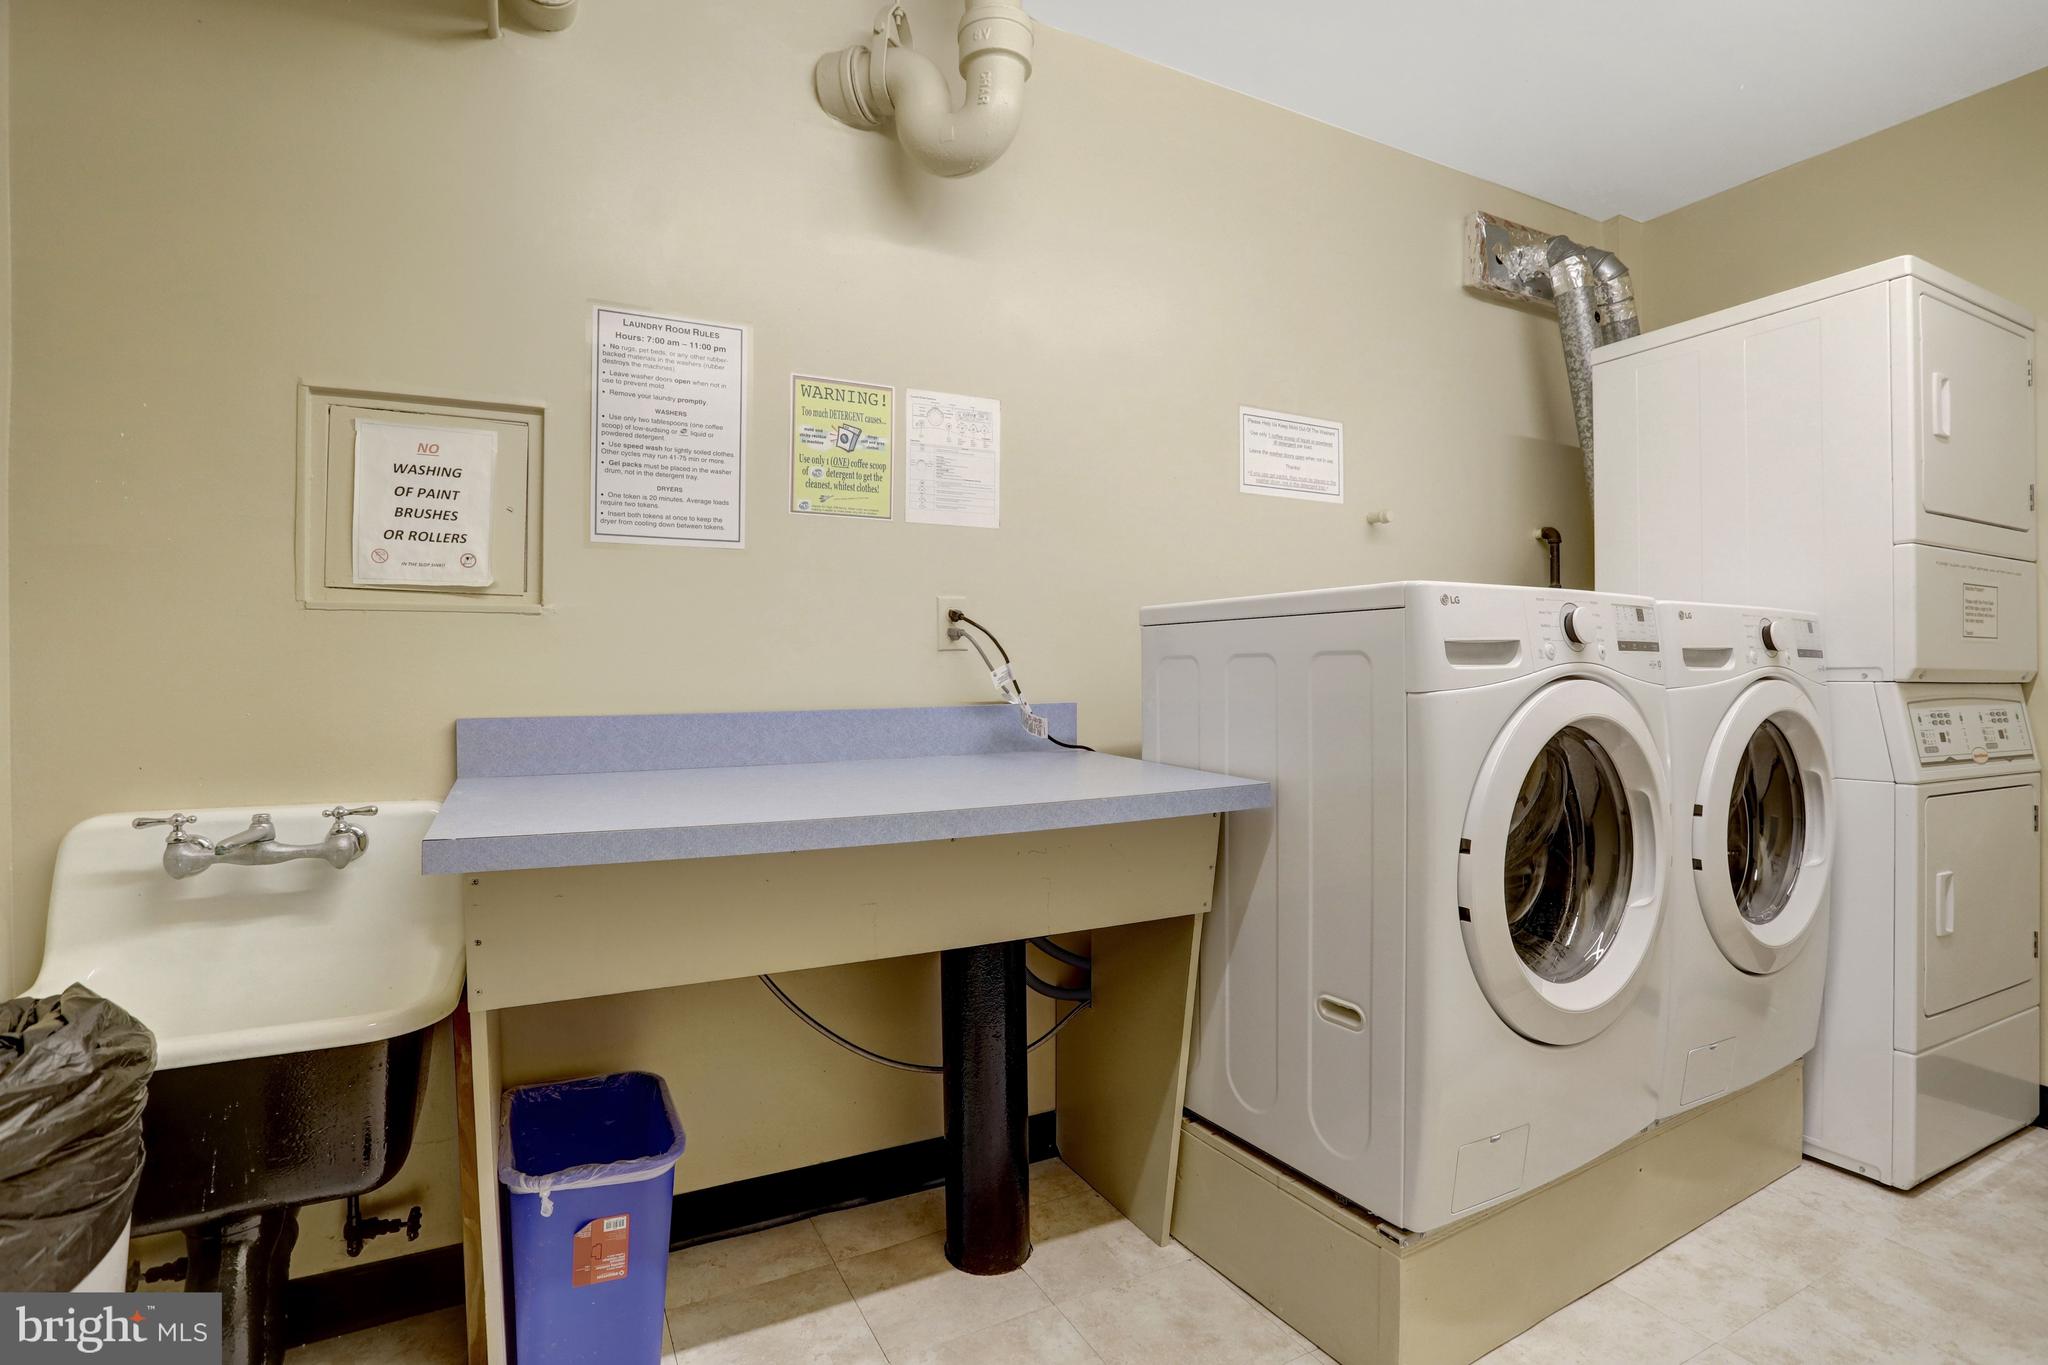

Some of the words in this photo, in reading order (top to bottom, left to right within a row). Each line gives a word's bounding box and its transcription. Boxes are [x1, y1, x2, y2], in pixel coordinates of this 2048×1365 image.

[623, 319, 662, 331] LAUNDRY
[666, 325, 690, 335] ROOM
[693, 328, 720, 339] RULES
[615, 332, 645, 342] Hours:
[647, 336, 665, 345] 7:00
[690, 342, 711, 351] 11:00
[602, 358, 630, 367] destroys
[628, 353, 656, 362] materials
[631, 372, 653, 380] washer
[624, 381, 647, 389] prevent
[609, 390, 636, 398] Remove
[653, 394, 676, 403] laundry
[801, 384, 887, 406] WARNING!
[655, 409, 687, 417] WASHERS
[802, 406, 812, 416] Too
[813, 410, 828, 418] much
[829, 410, 864, 422] DETERGENT
[651, 417, 688, 427] tablespoons
[690, 420, 702, 428] (one
[705, 422, 723, 430] coffee
[601, 431, 632, 439] powdered
[416, 442, 440, 456] NO
[621, 450, 640, 458] cycles
[623, 443, 644, 451] speed
[674, 446, 692, 454] lightly
[622, 461, 642, 469] packs
[670, 465, 690, 473] placed
[799, 454, 810, 464] Use
[811, 457, 825, 467] only
[831, 458, 849, 468] (ONE)
[851, 459, 869, 469] coffee
[870, 463, 886, 472] scoop
[393, 463, 463, 479] WASHING
[656, 471, 684, 479] detergent
[802, 466, 809, 476] of
[826, 469, 855, 480] detergent
[863, 473, 872, 482] get
[874, 472, 883, 481] the
[834, 482, 855, 491] whitest
[394, 486, 414, 497] OF
[417, 487, 460, 501] PAINT
[394, 507, 458, 521] BRUSHES
[635, 519, 656, 528] cooling
[383, 529, 404, 541] OR
[408, 530, 467, 544] ROLLERS
[1450, 596, 1460, 605] LG
[1685, 612, 1692, 620] LG
